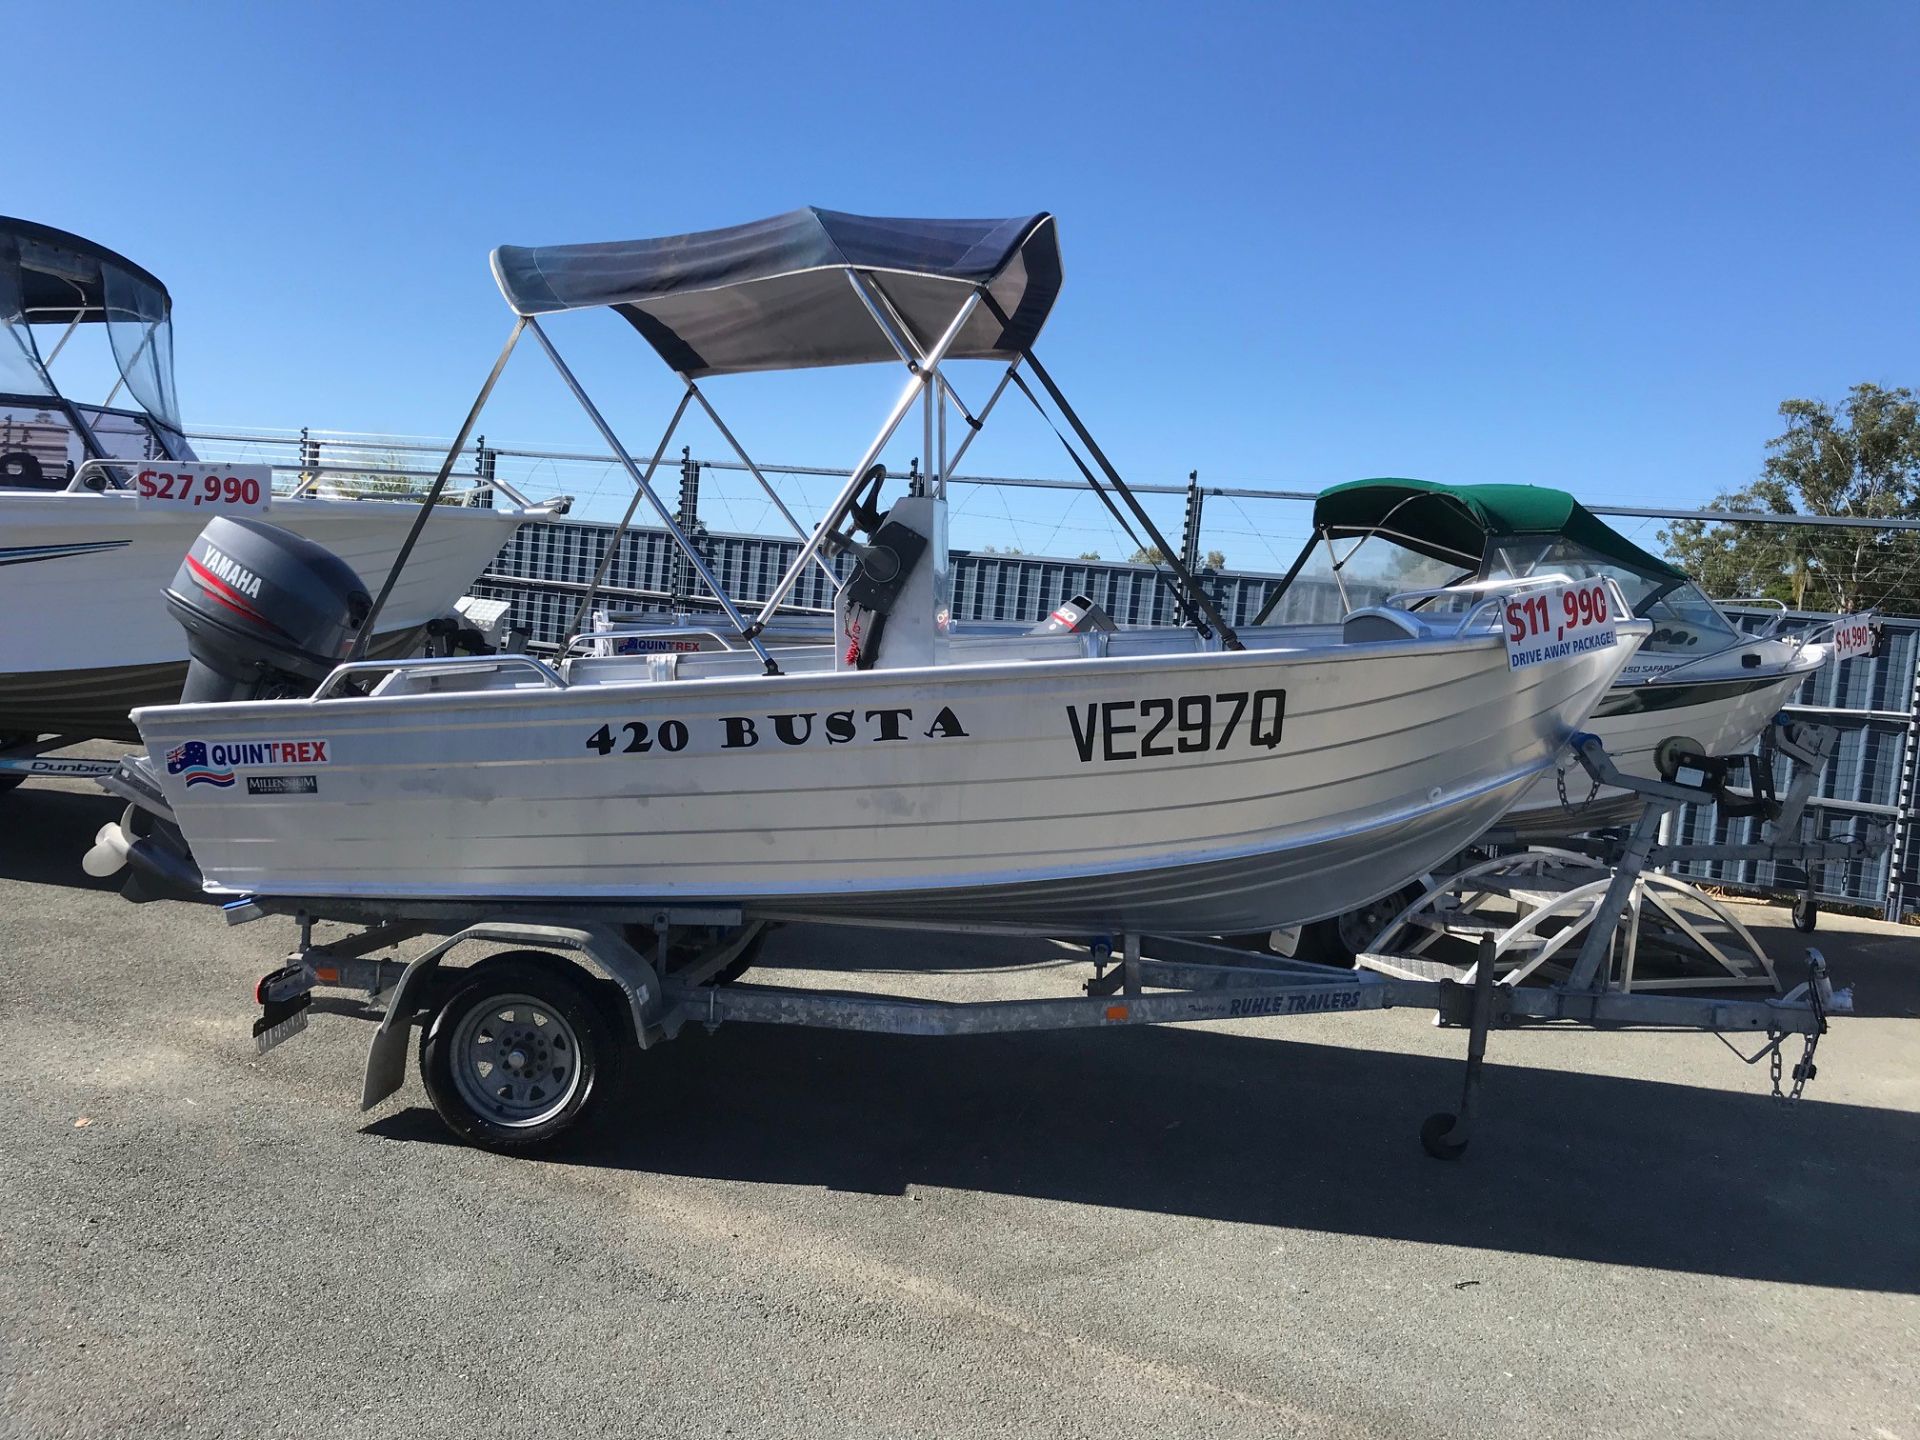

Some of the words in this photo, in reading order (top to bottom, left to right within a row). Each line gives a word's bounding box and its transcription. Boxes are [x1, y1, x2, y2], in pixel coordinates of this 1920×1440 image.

[138, 468, 260, 506] $27,990
[202, 544, 262, 599] YAMAHA
[1056, 607, 1077, 622] 50
[638, 640, 700, 652] QUINTREX
[1511, 649, 1542, 667] DRIVE
[1544, 642, 1571, 660] AWAY
[1573, 631, 1614, 653] PACKAGE!
[1836, 626, 1868, 654] $14,990
[586, 719, 689, 755] 420
[718, 705, 970, 749] BUSTA
[1066, 689, 1286, 763] VE297Q
[31, 761, 117, 773] Dunbier
[212, 741, 328, 766] QUINTREX
[249, 777, 315, 788] MILLENUM
[1230, 995, 1283, 1016] RUHLE
[1287, 990, 1361, 1013] TRAILERS
